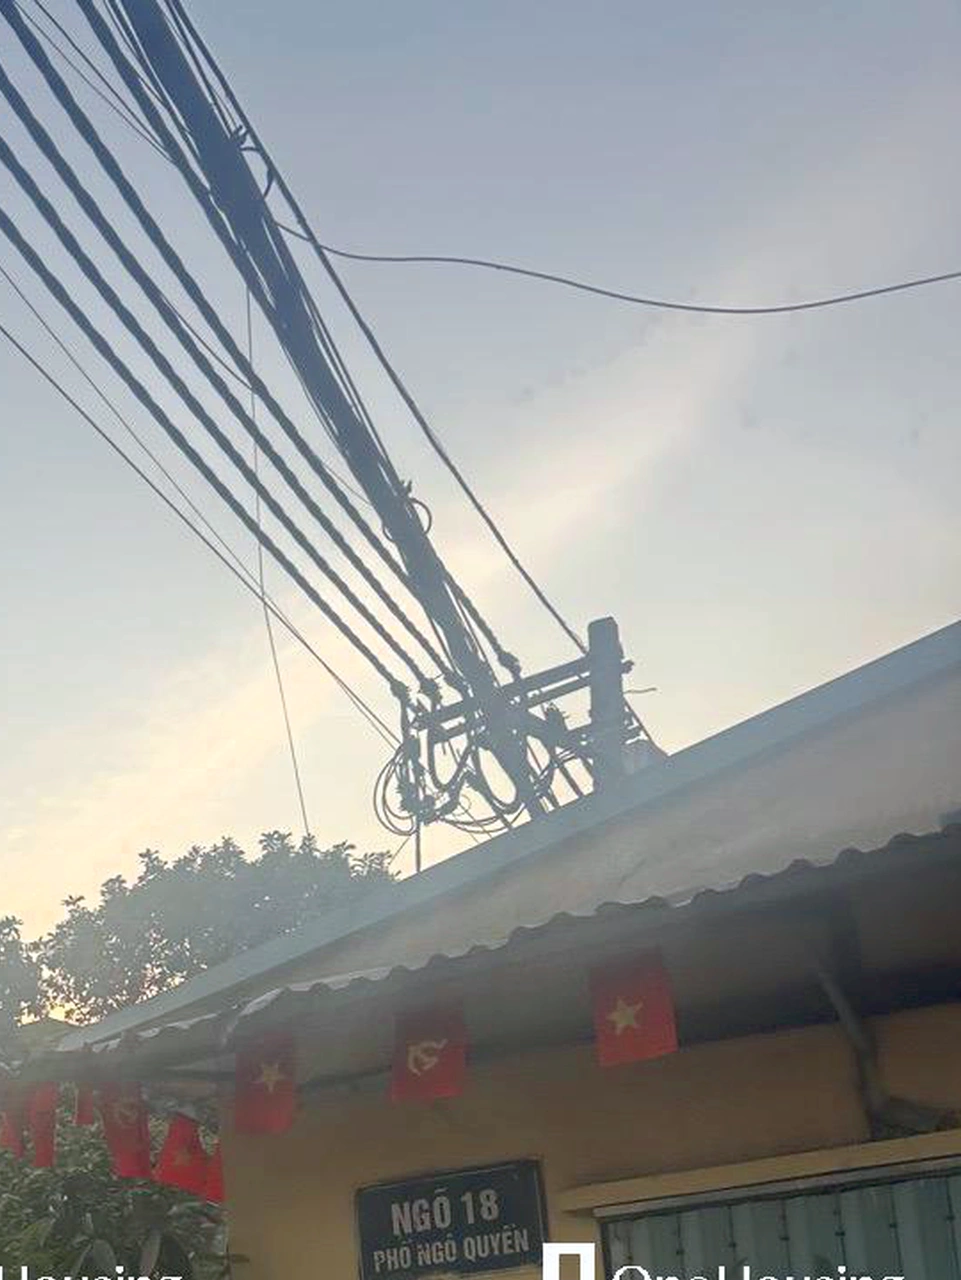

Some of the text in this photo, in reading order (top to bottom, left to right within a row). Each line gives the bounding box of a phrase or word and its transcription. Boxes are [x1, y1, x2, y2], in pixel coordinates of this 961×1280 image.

[391, 1187, 499, 1236] NGÕ 18
[373, 1222, 530, 1273] PHỐ NGÔ QUYỀN
